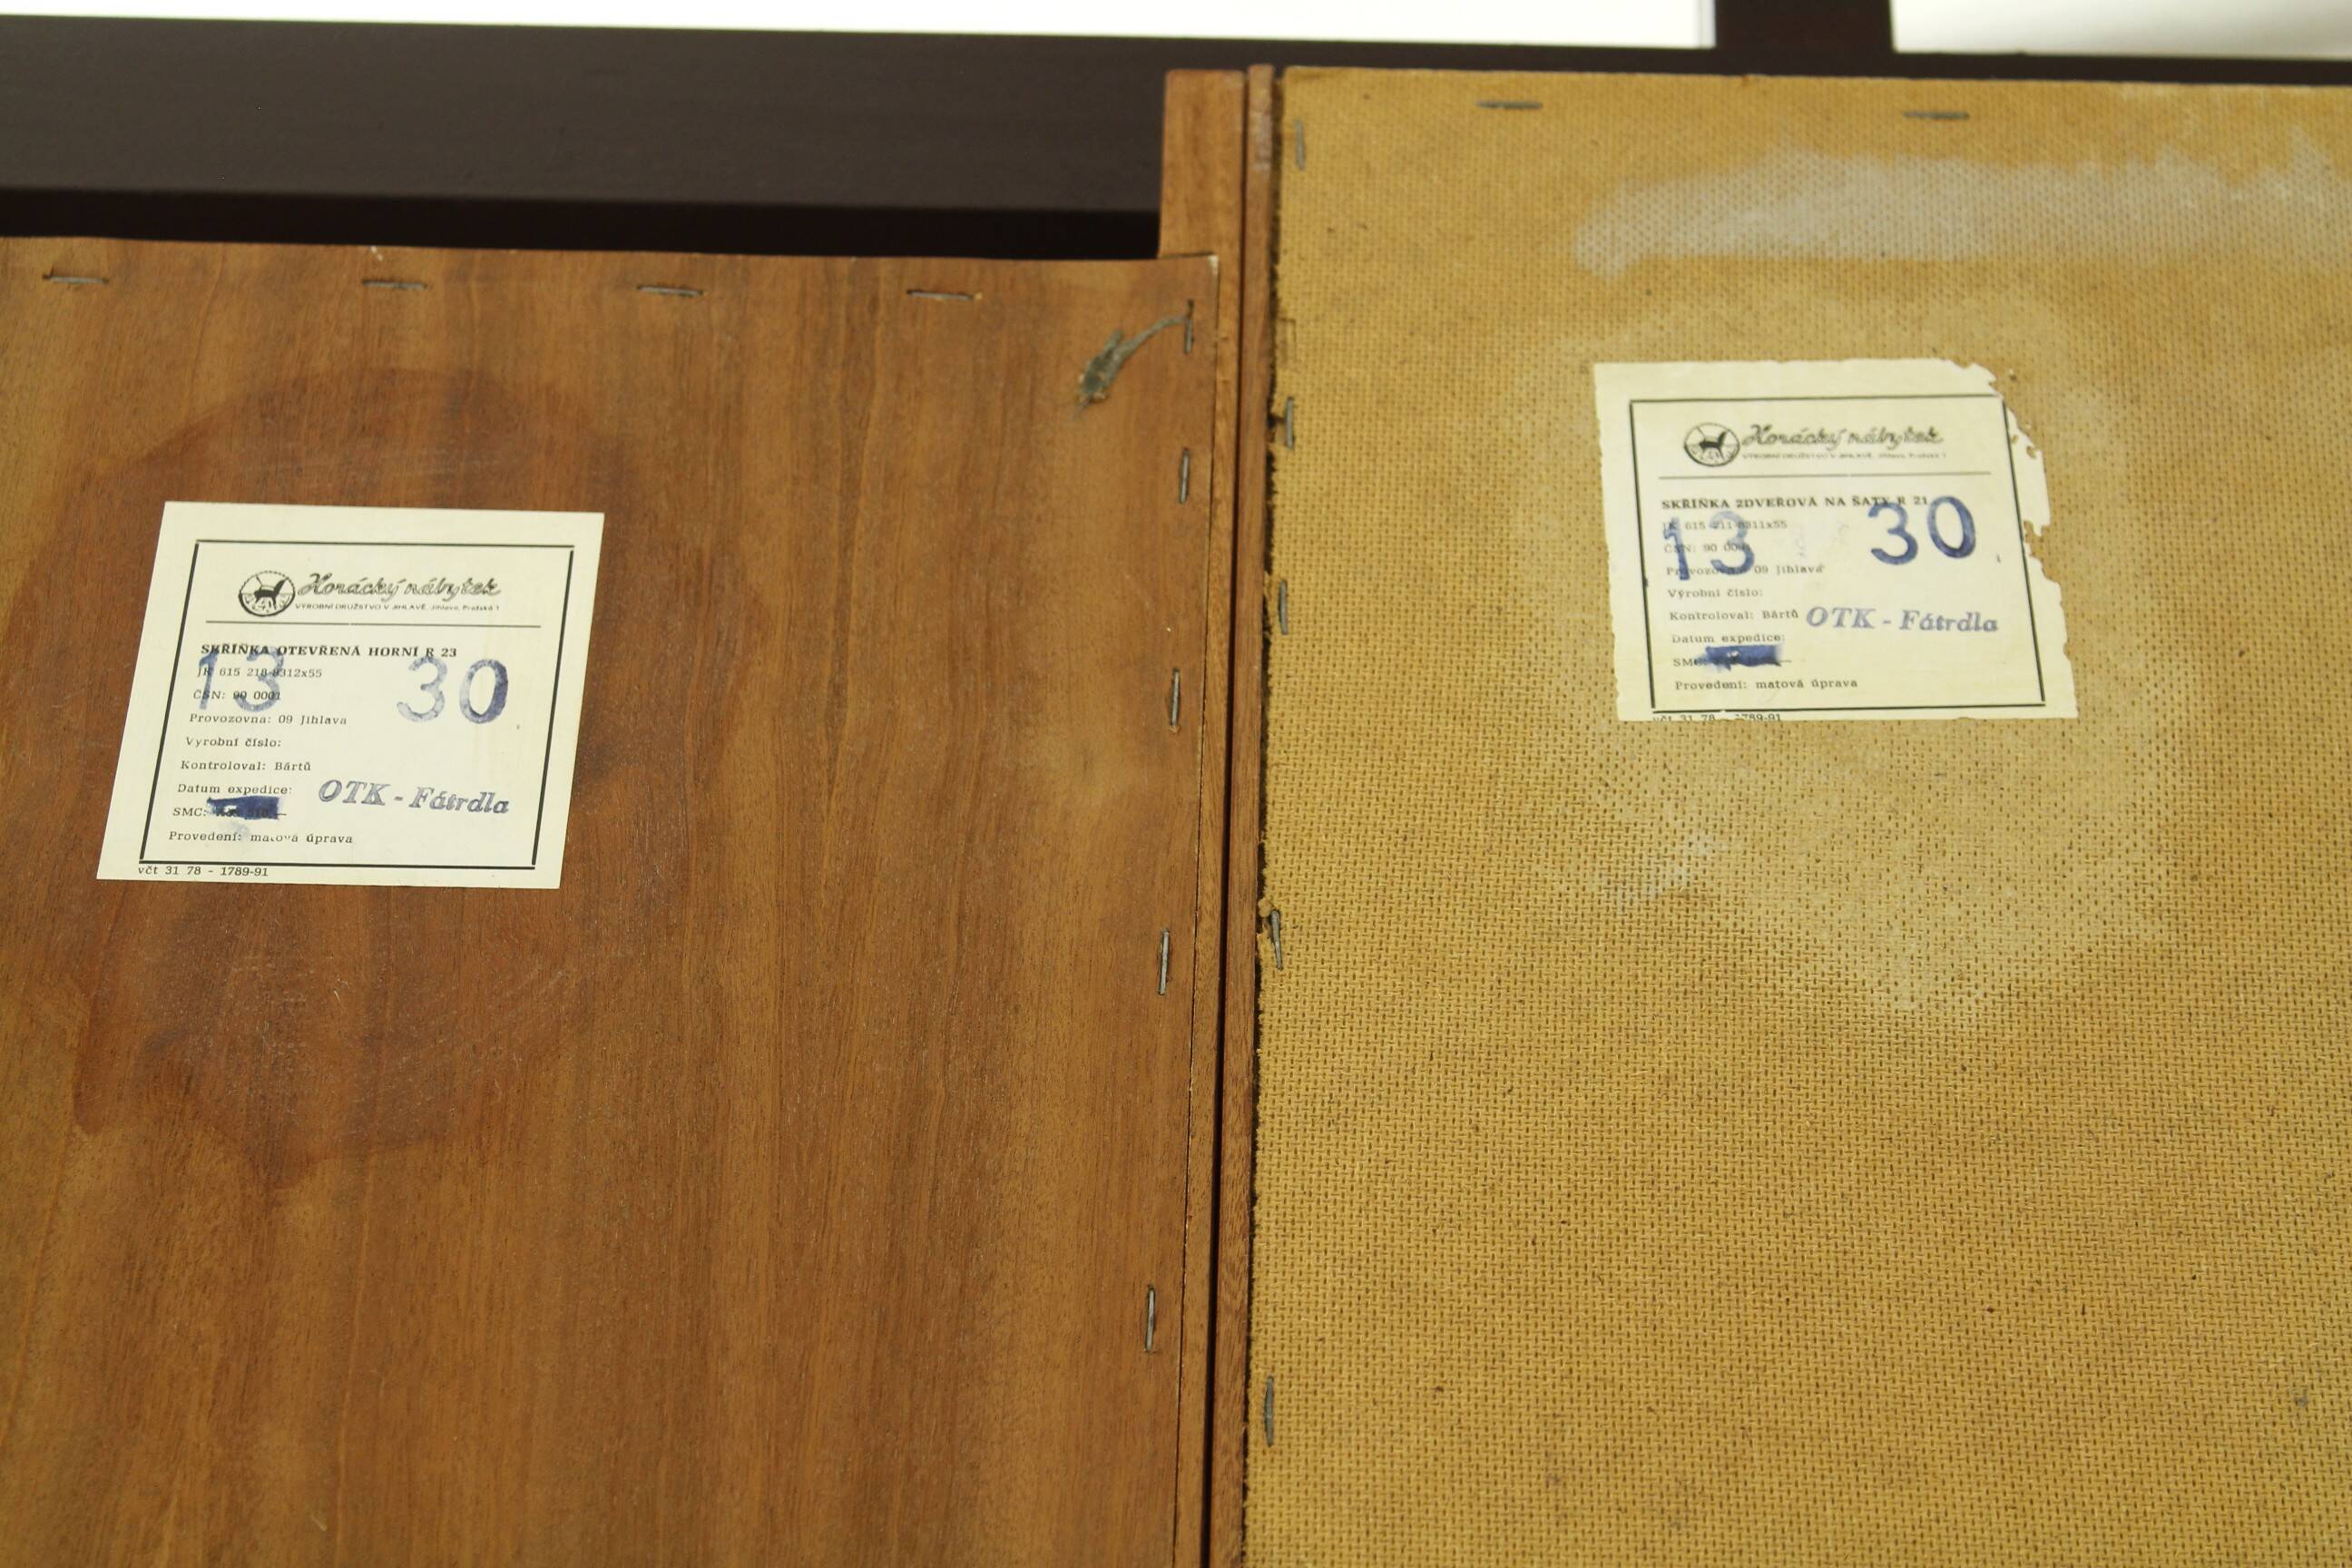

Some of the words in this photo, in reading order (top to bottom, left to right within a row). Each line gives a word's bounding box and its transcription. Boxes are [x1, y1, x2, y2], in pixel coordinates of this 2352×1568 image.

[1826, 496, 1846, 506] NA
[1852, 495, 1890, 506] ŠATY
[1898, 496, 1906, 505] R
[1914, 496, 1927, 505] 21
[1685, 521, 1707, 530] 615
[1867, 496, 1976, 564] 30
[1663, 511, 1755, 581] 13
[1703, 544, 1718, 553] 90
[1755, 564, 1769, 573] 09
[1727, 588, 1763, 599] číslo:
[1670, 611, 1754, 621] Kontroloval:
[1806, 606, 1876, 629] OTK
[1899, 610, 1999, 632] Fátrdla
[1672, 634, 1714, 643] Datum
[1722, 633, 1785, 645] expedice:
[201, 643, 270, 655] SKŘÍŇKA
[277, 644, 360, 656] OTEVŘENÁ
[368, 645, 418, 657] HORNÍ
[426, 648, 435, 657] R
[441, 648, 456, 657] 23
[220, 668, 240, 677] 615
[199, 647, 284, 712] 13
[397, 656, 508, 724] 30
[1675, 681, 1747, 691] Provedení:
[1757, 680, 1804, 690] matová
[190, 713, 271, 724] Provozovna:
[278, 715, 293, 724] 09
[300, 715, 347, 726] Jihlava
[245, 736, 281, 747] číslo:
[181, 760, 266, 770] Kontroloval:
[178, 783, 220, 794] Datum
[228, 784, 292, 795] expedice:
[318, 779, 390, 806] OTK
[408, 786, 509, 814] Fátrdla
[172, 807, 207, 817] SMC:
[169, 830, 242, 842] Provedení:
[306, 833, 353, 845] úprava
[138, 866, 158, 876] včt
[165, 866, 179, 875] 31
[187, 867, 201, 876] 78
[220, 868, 269, 877] 1789-91
